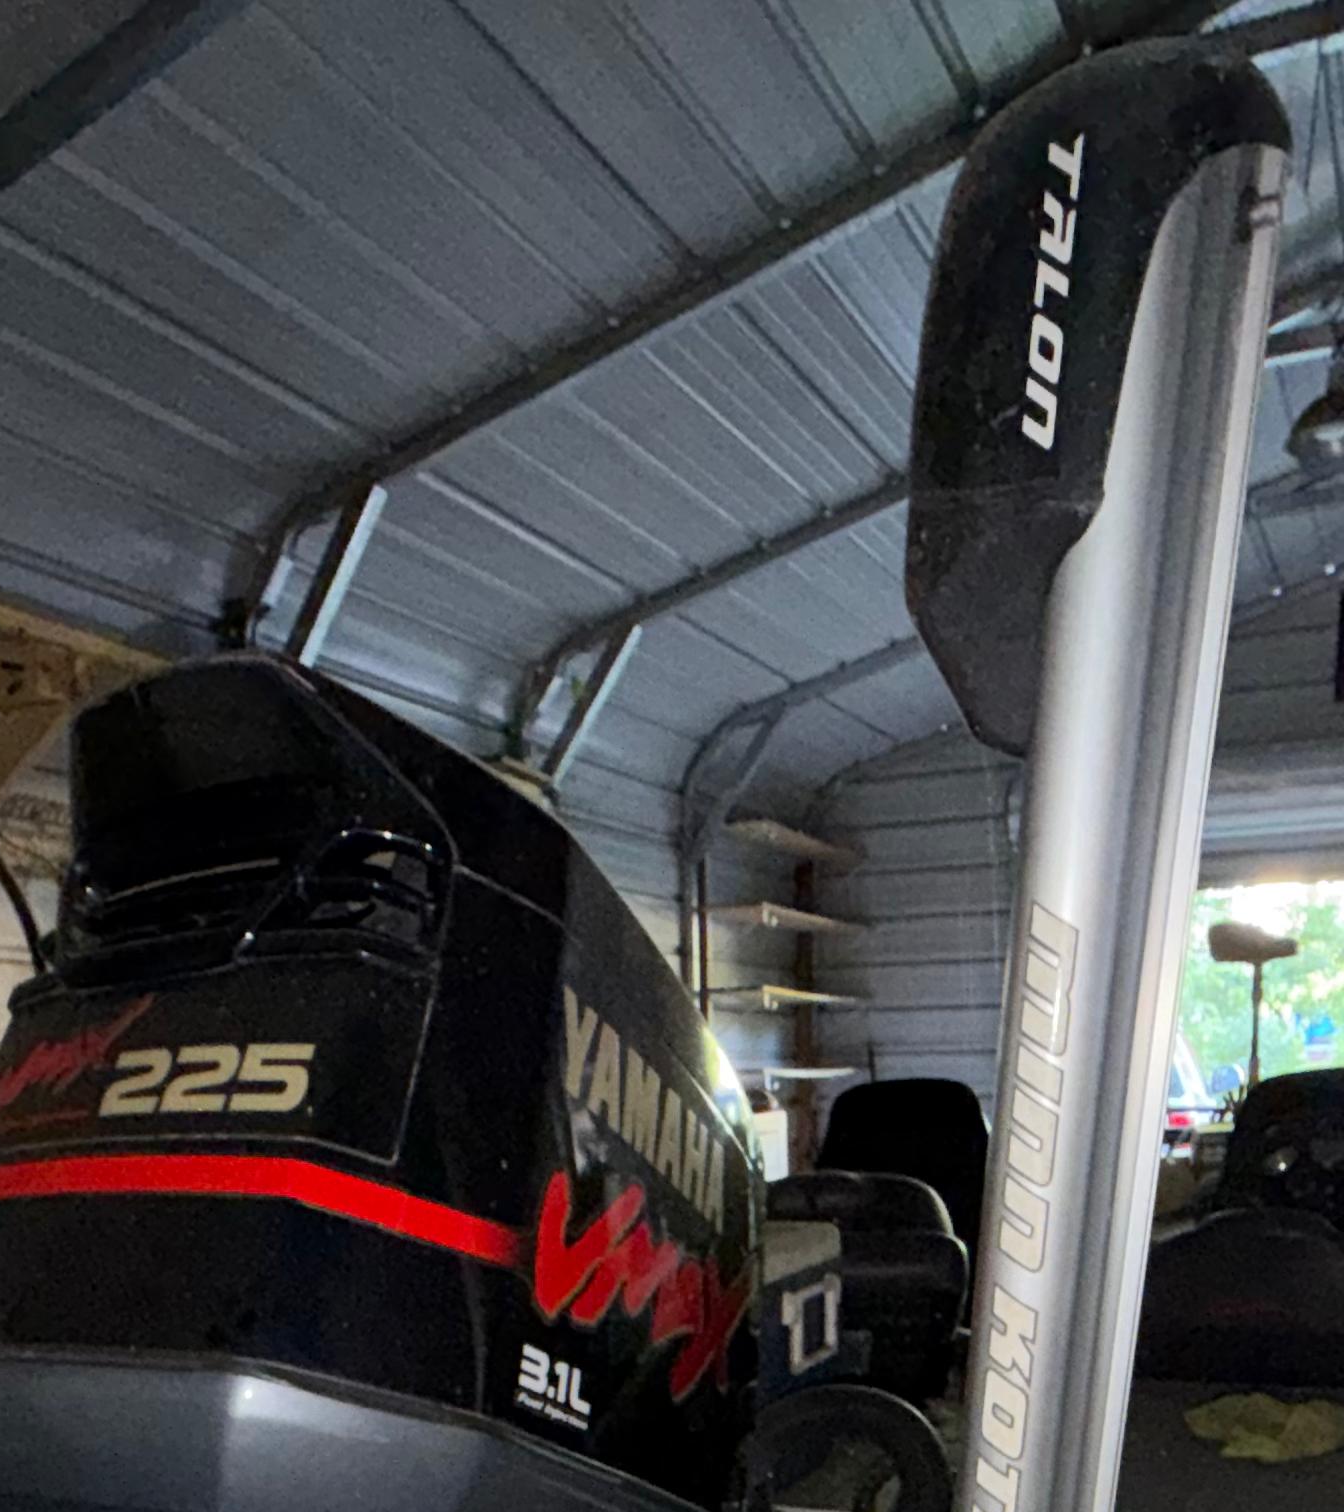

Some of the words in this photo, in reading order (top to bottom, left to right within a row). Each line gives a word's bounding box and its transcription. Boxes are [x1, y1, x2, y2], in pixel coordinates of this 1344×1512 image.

[98, 1043, 316, 1118] 225
[563, 986, 725, 1235] YAMAHA
[518, 1343, 592, 1416] 3.1L
